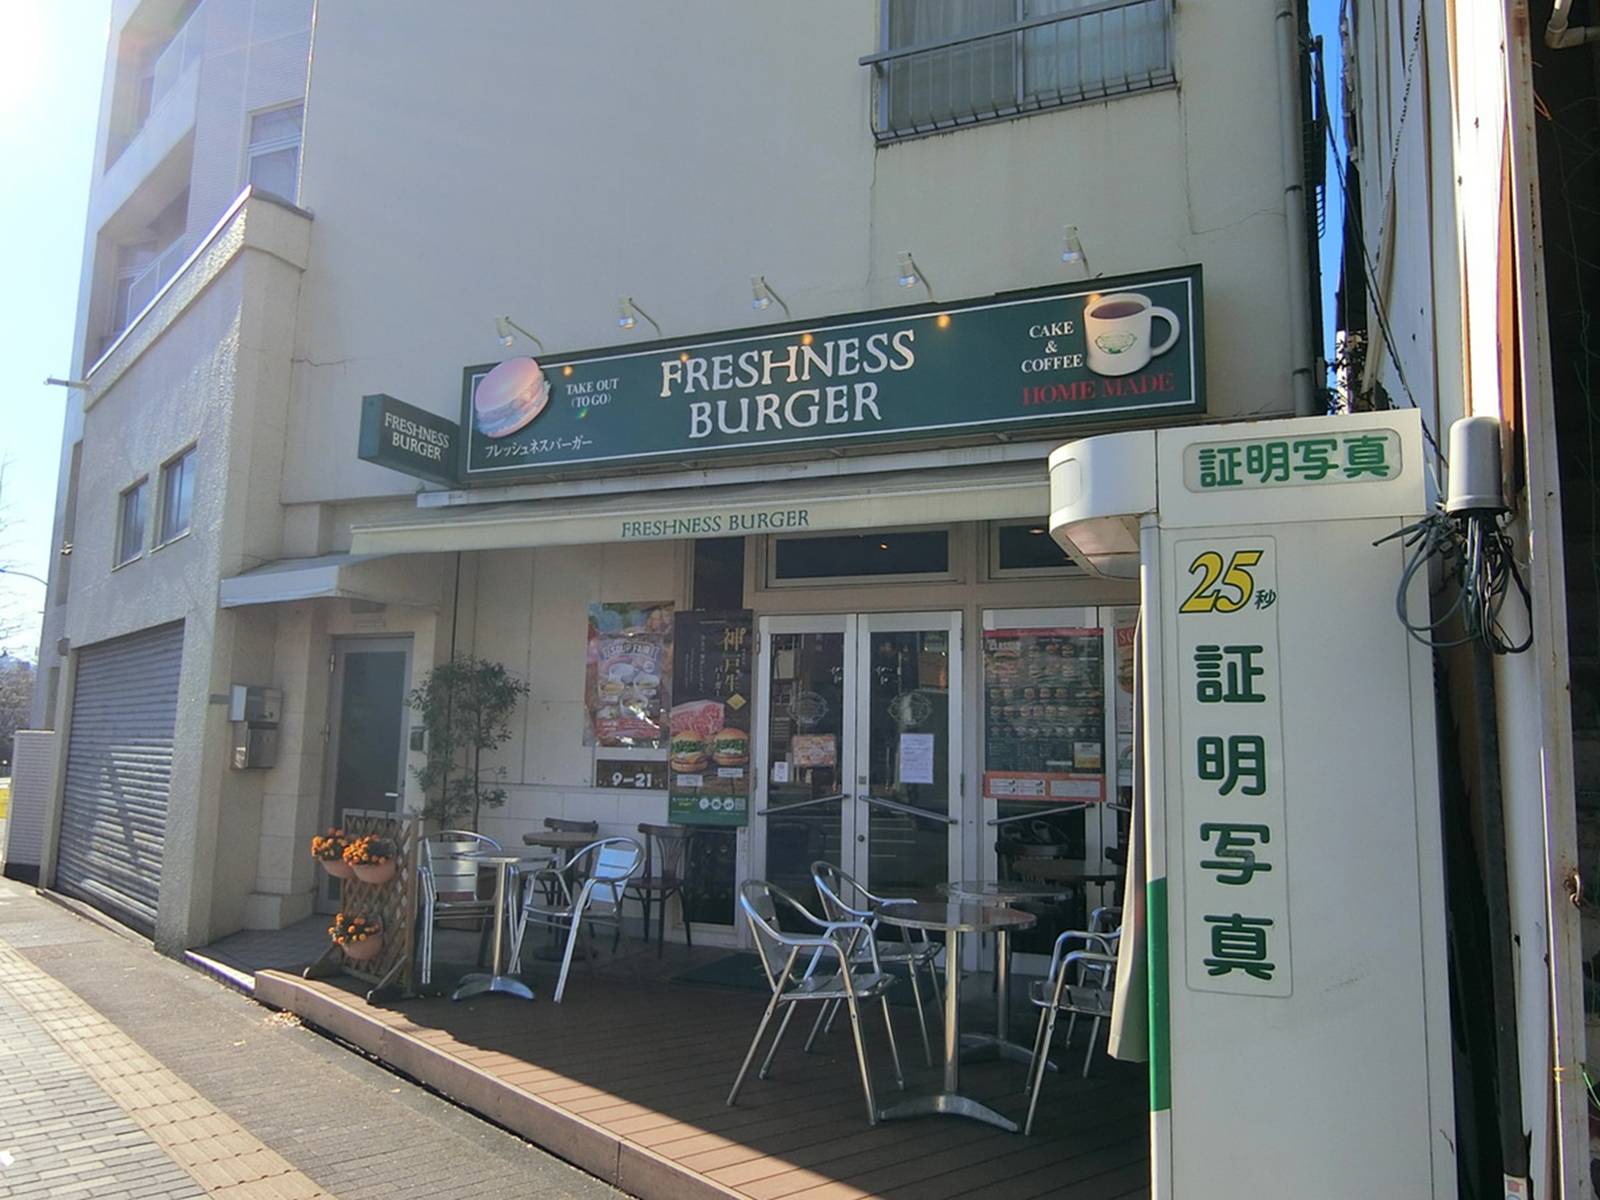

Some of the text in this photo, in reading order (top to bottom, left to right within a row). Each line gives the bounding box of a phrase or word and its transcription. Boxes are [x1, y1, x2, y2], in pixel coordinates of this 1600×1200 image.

[1029, 321, 1074, 338] CAKE
[1045, 340, 1058, 353] &
[660, 329, 915, 397] FRESHNESS
[1021, 354, 1083, 373] COFFEE
[566, 378, 619, 395] TAKE OUT
[1022, 373, 1175, 405] HOME MADE
[689, 382, 881, 438] BURGER
[385, 412, 450, 448] FRESHNESS
[392, 432, 441, 460] BURGER
[485, 435, 593, 458] フレッシュネスバーガー
[1198, 435, 1390, 487] 証明写真
[621, 510, 810, 537] FRESHNESS BURGER
[610, 643, 632, 655] SOUP
[612, 772, 652, 787] 9-21
[1194, 644, 1275, 980] 証明写真
